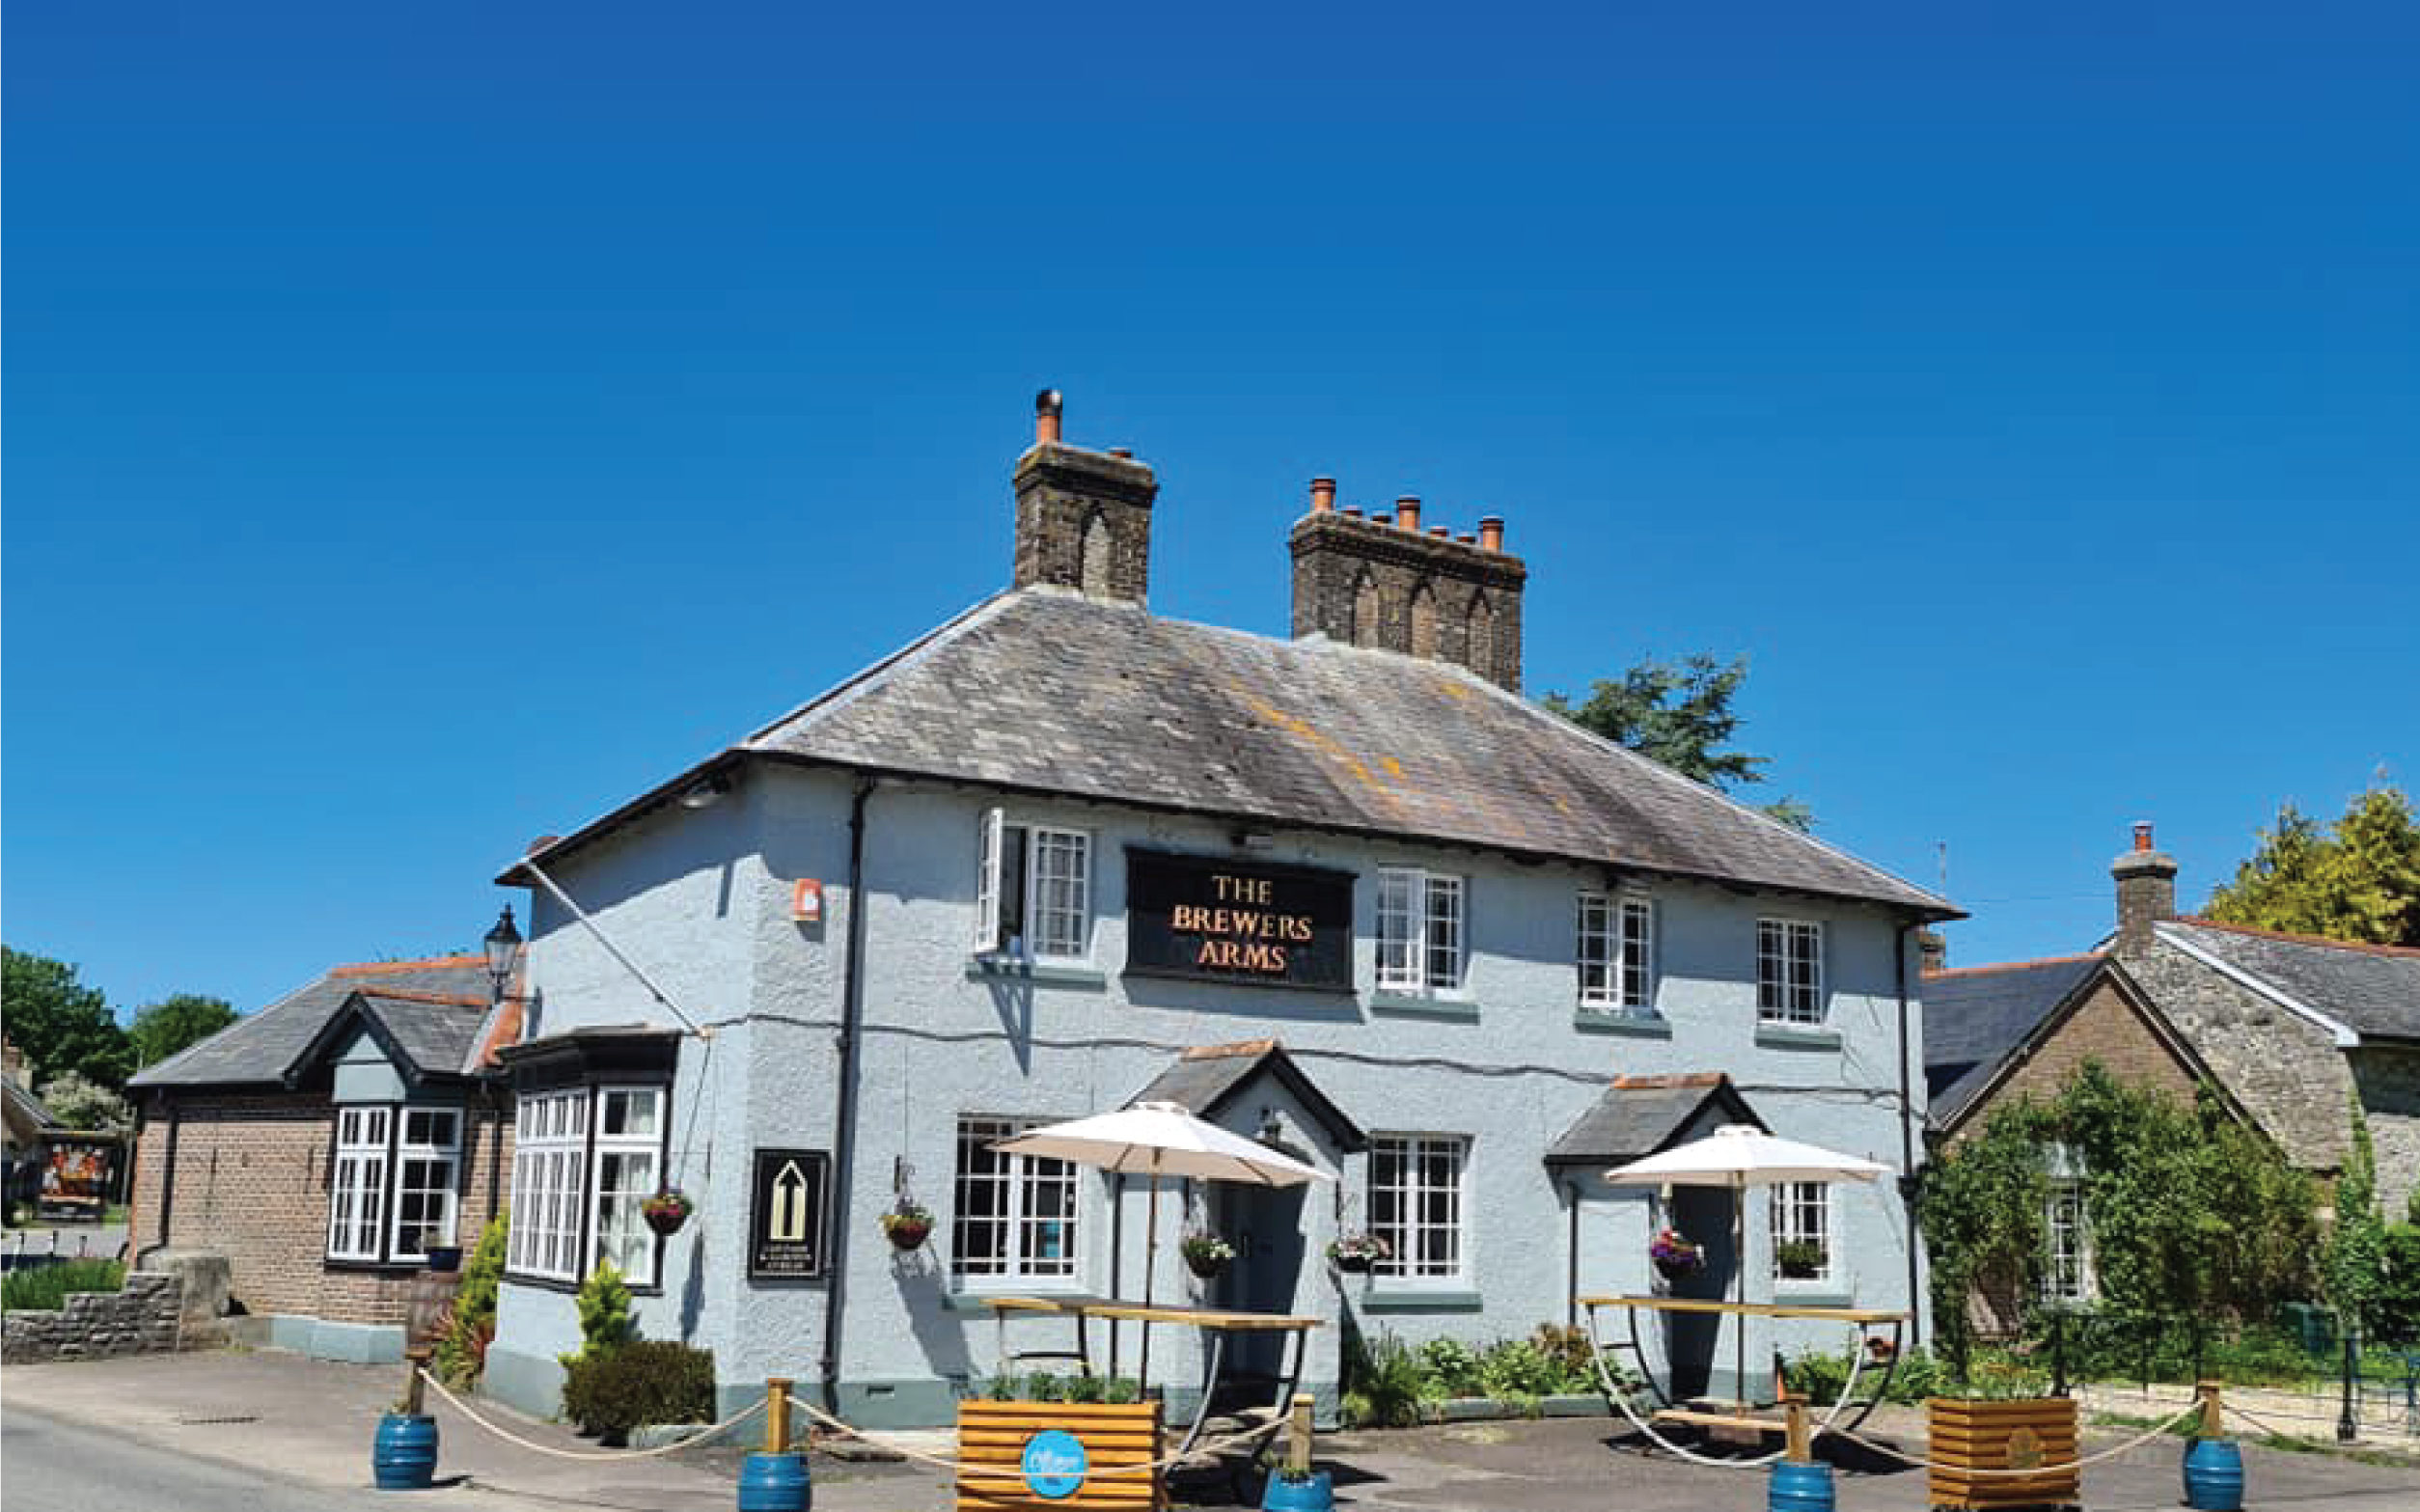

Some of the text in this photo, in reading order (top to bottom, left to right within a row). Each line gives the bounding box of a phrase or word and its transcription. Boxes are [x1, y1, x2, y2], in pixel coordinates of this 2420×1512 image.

[1212, 875, 1274, 905] THE
[1170, 904, 1314, 940] BREWERS
[1198, 941, 1286, 971] ARMS
